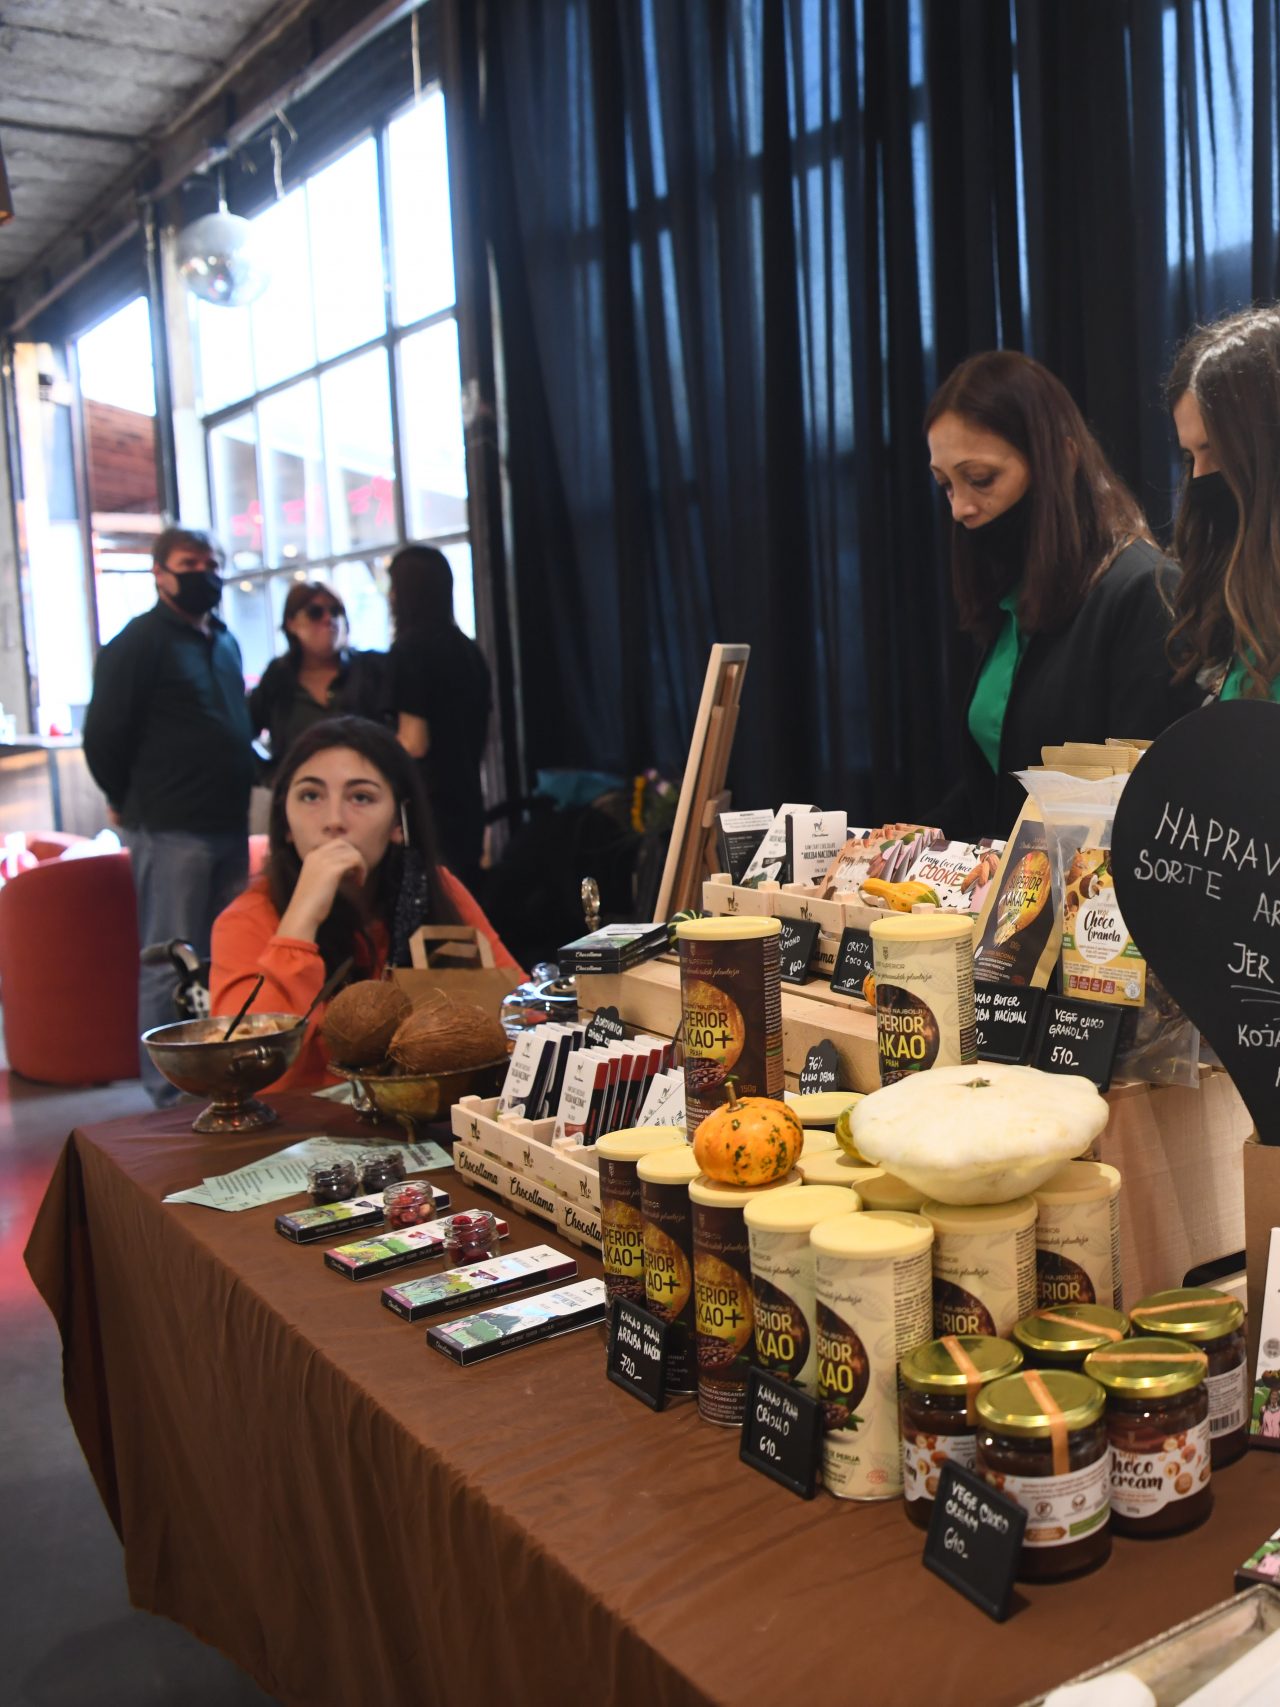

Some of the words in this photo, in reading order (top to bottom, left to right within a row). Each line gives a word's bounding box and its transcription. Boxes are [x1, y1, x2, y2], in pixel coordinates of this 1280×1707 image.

[1134, 849, 1223, 901] SORTE
[1084, 909, 1115, 931] Choco
[1087, 926, 1122, 943] Granola
[845, 955, 862, 967] COCO
[1227, 942, 1275, 985] JER
[993, 994, 1021, 1007] BUTER
[1048, 1023, 1090, 1041] GRANOLA
[1080, 1017, 1105, 1029] CHOCO
[808, 1056, 824, 1071] 76%
[459, 1151, 498, 1186] Chocollama
[509, 1177, 554, 1213] Chocollama
[617, 1325, 642, 1351] ARRIBA
[620, 1310, 641, 1331] KAKAO
[643, 1324, 660, 1345] PRAH
[757, 1384, 782, 1406] KAKAO
[782, 1396, 800, 1420] PRAH
